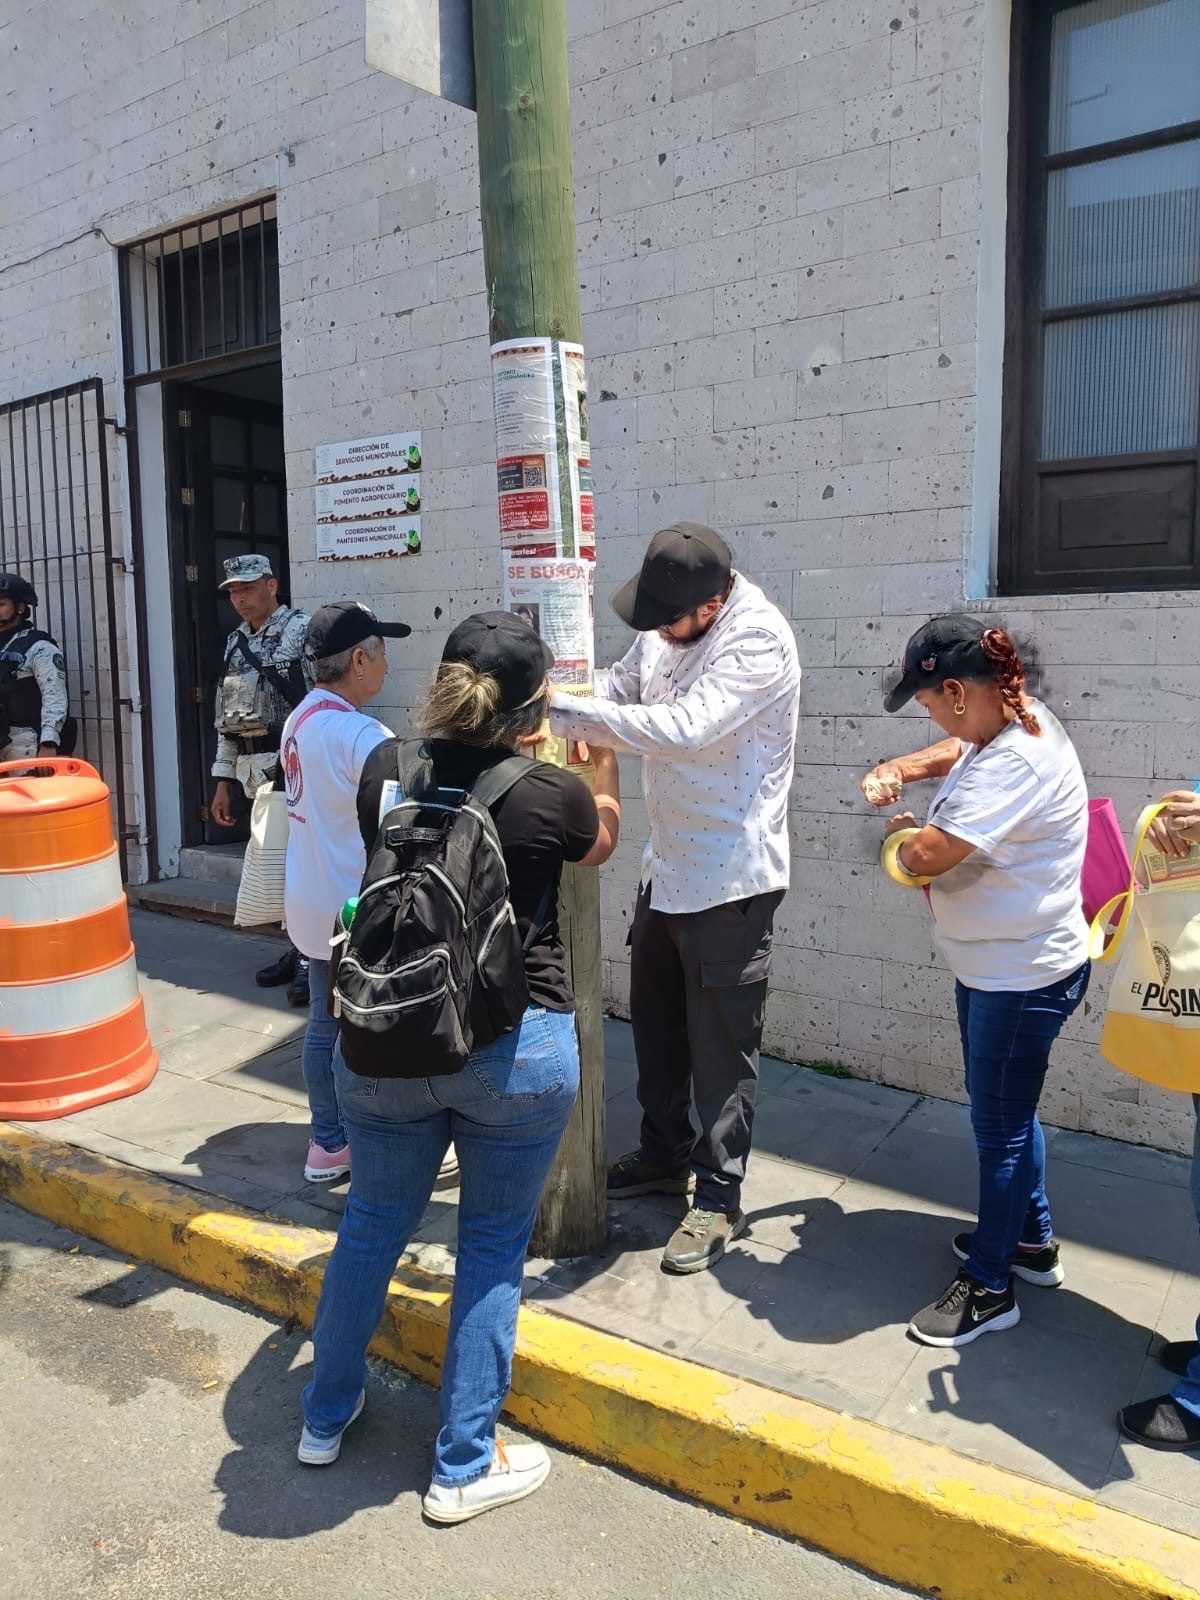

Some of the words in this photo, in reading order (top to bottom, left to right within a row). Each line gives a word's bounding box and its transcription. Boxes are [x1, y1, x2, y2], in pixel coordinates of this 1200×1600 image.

[348, 443, 379, 455] DIRECCIÓN
[380, 442, 390, 450] DE
[335, 455, 364, 466] SERVICIOS
[365, 449, 406, 461] MUNICIPALES
[342, 485, 385, 496] COORDINACIÓN
[333, 496, 360, 506] FOMENTO
[361, 491, 407, 502] AGROPECUARIO
[345, 525, 387, 536] COORDINACIÓN
[336, 536, 368, 545] PANTEONES
[369, 533, 407, 541] MUNICIPALES
[508, 566, 526, 579] SE
[530, 565, 585, 580] BUSCA
[1130, 981, 1143, 995] EL
